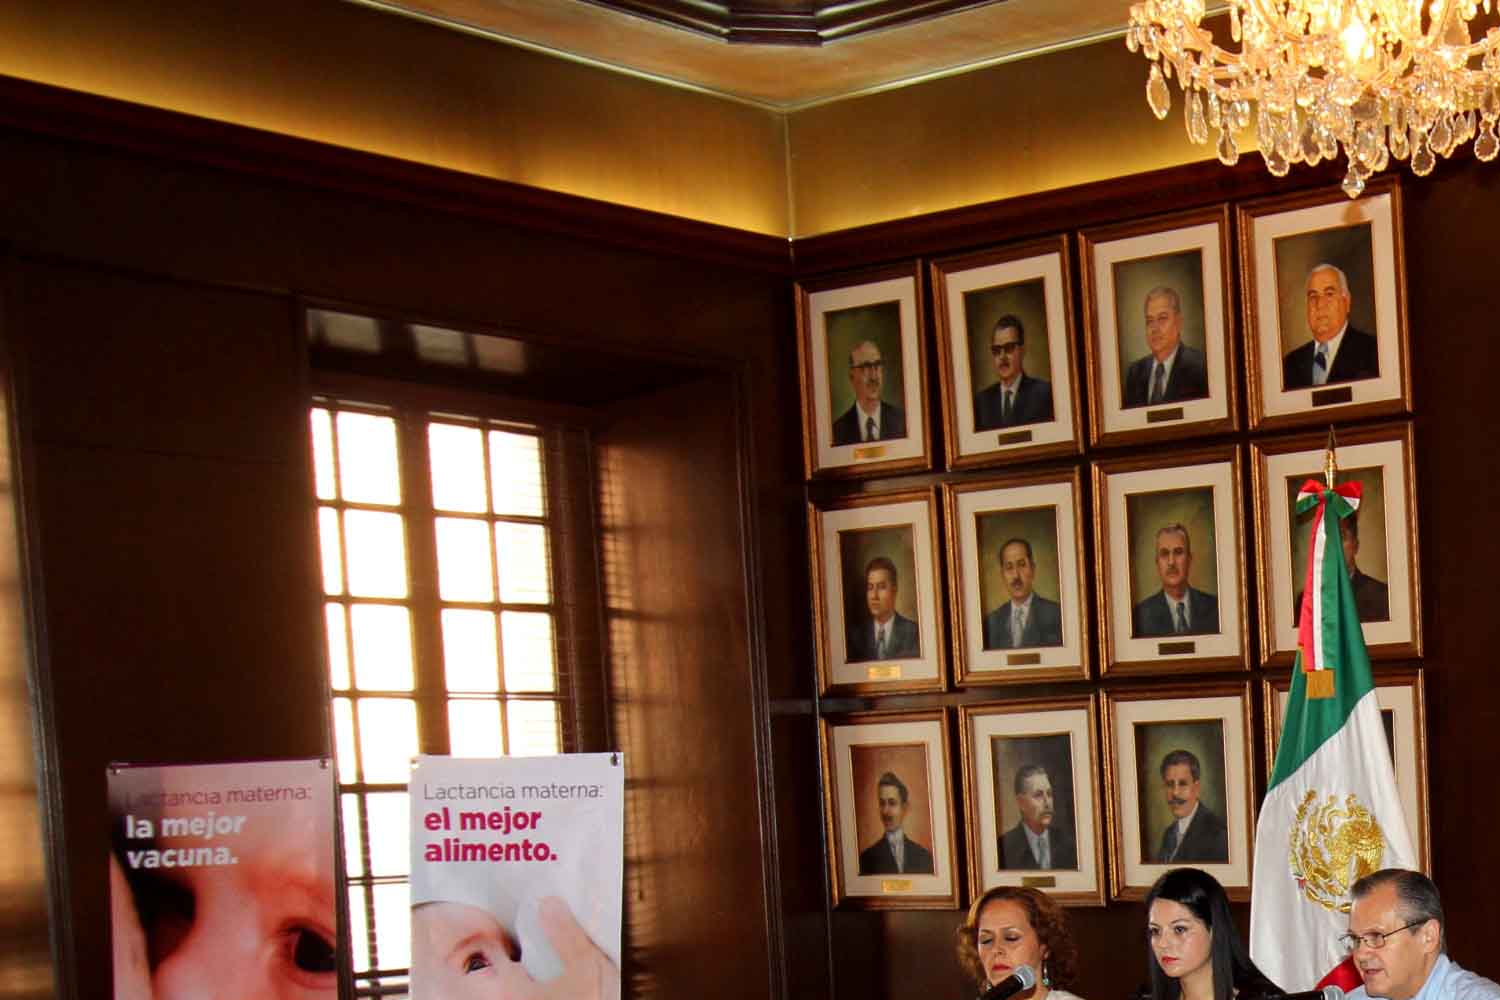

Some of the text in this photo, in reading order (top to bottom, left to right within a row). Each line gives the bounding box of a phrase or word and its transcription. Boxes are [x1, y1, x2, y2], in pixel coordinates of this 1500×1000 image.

[227, 786, 312, 803] materna:
[424, 783, 604, 800] Lactancia materna:
[126, 812, 246, 839] la mejor
[424, 806, 542, 835] el mejor
[127, 847, 239, 869] vacuna.
[424, 838, 557, 862] alimento.
